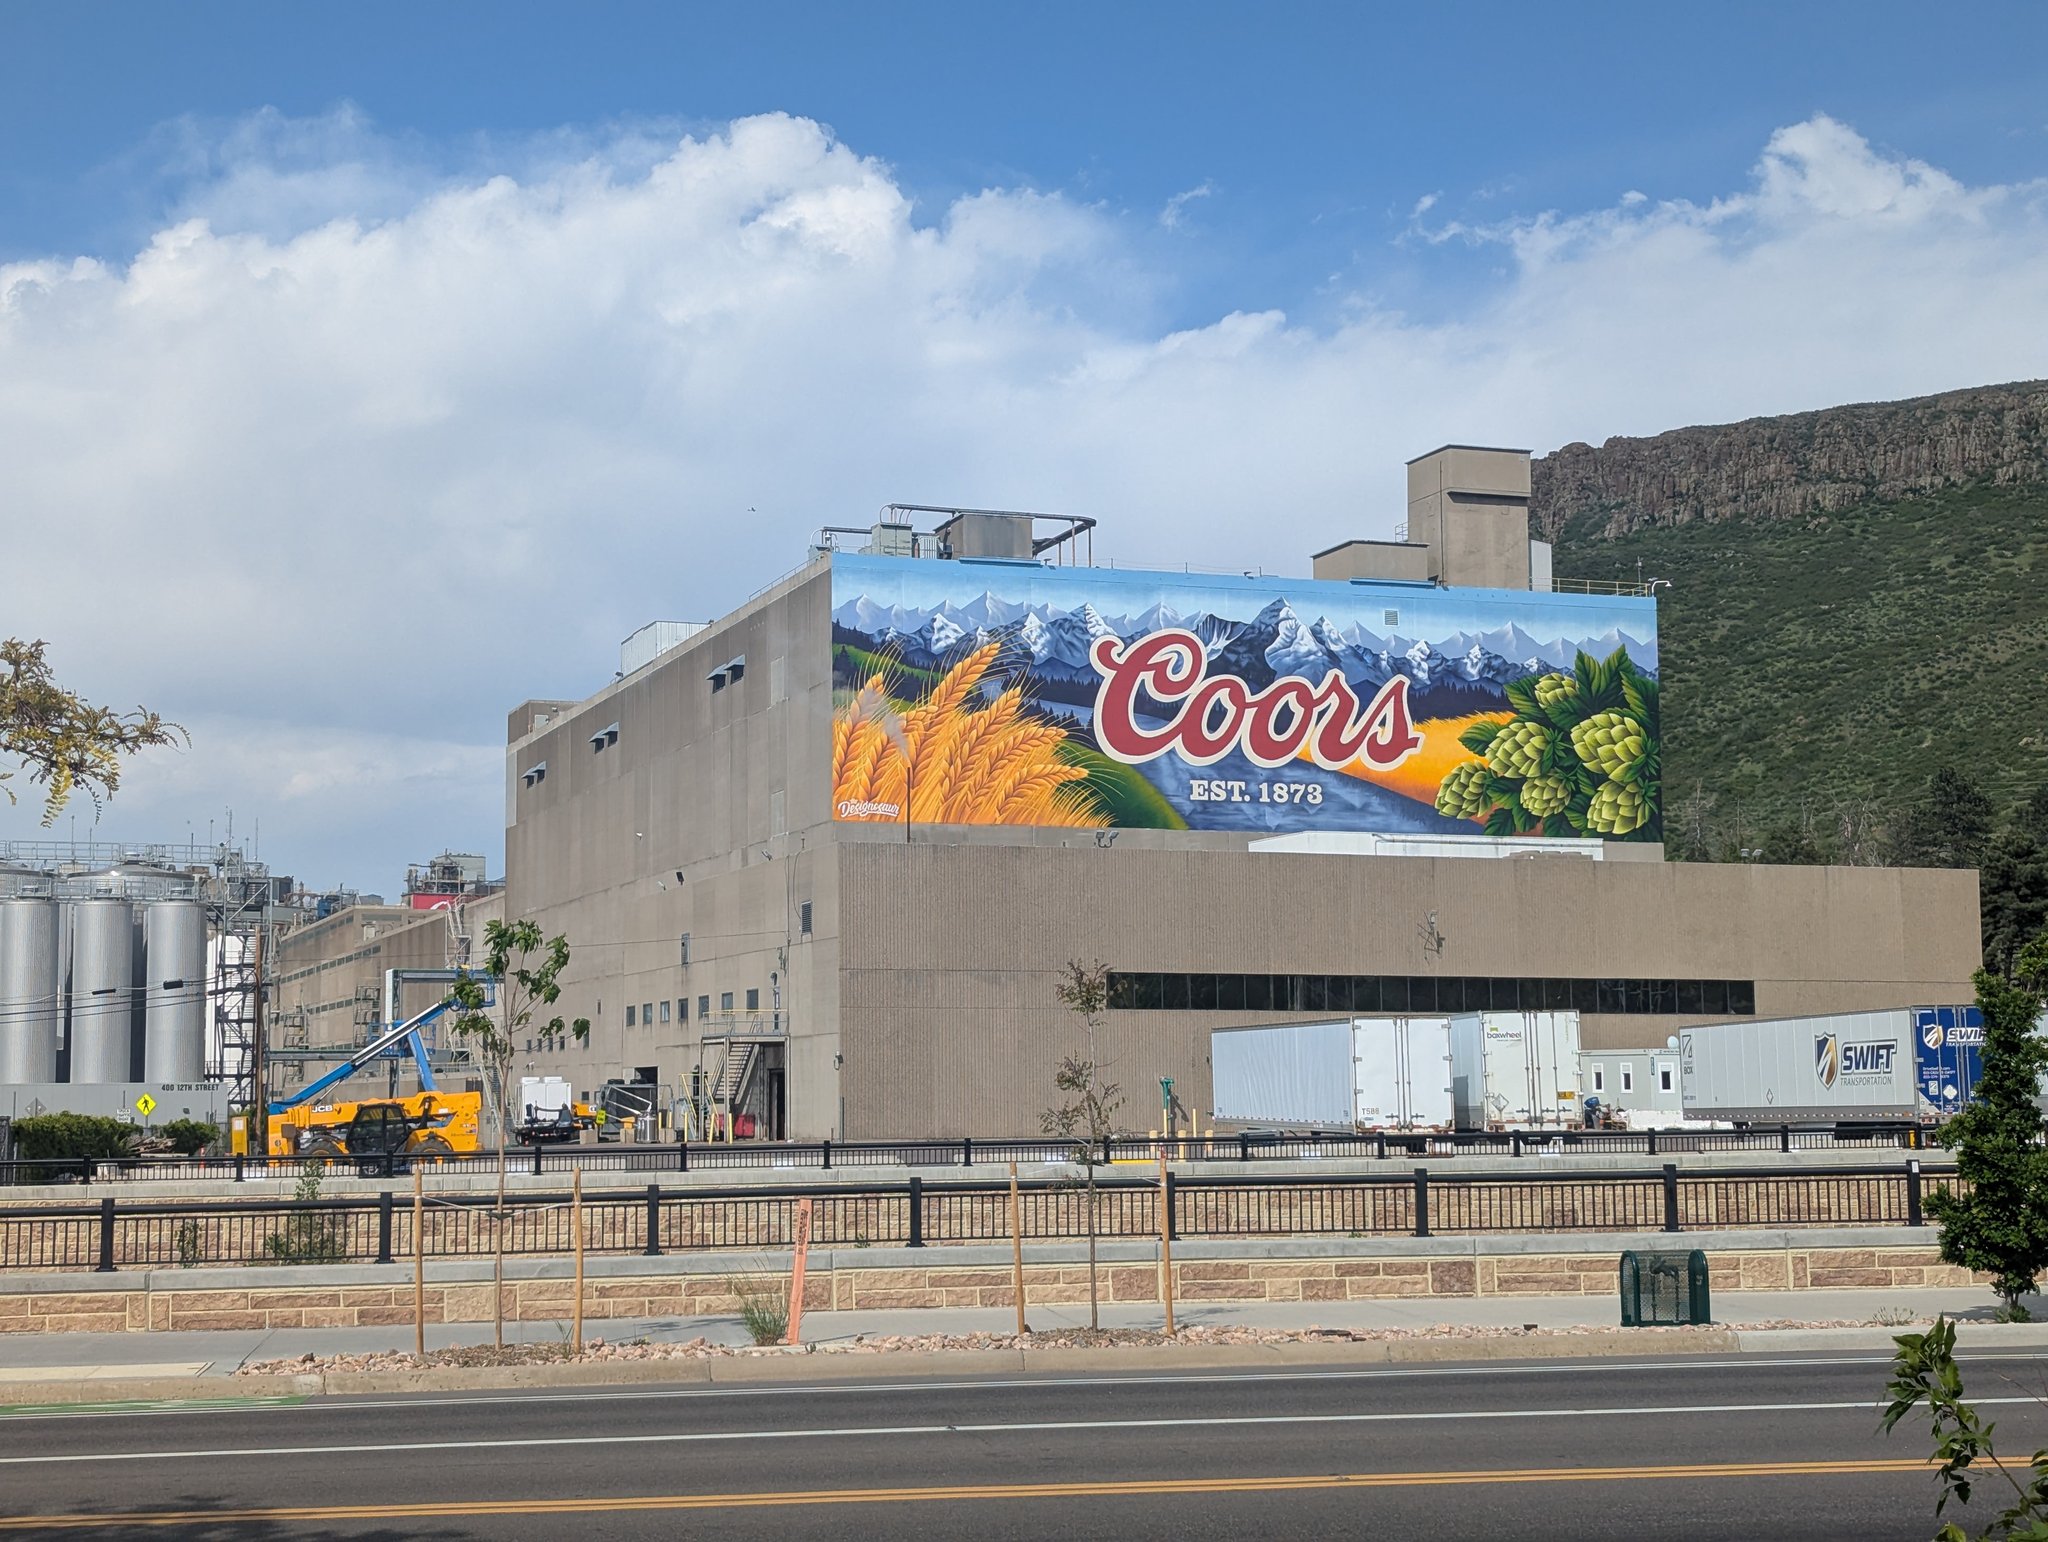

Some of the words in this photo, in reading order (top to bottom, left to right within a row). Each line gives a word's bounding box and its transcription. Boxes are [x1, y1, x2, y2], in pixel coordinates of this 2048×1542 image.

[1089, 628, 1425, 772] Coors
[1189, 779, 1251, 802] EST.
[1258, 782, 1323, 804] 1873
[837, 800, 900, 818] Designosaur
[1946, 1027, 1987, 1042] SWIF
[1841, 1040, 1897, 1074] SWIFT
[1683, 1066, 1694, 1075] BOX
[1840, 1076, 1892, 1086] TRANSPORTATION
[311, 1105, 333, 1113] JCB
